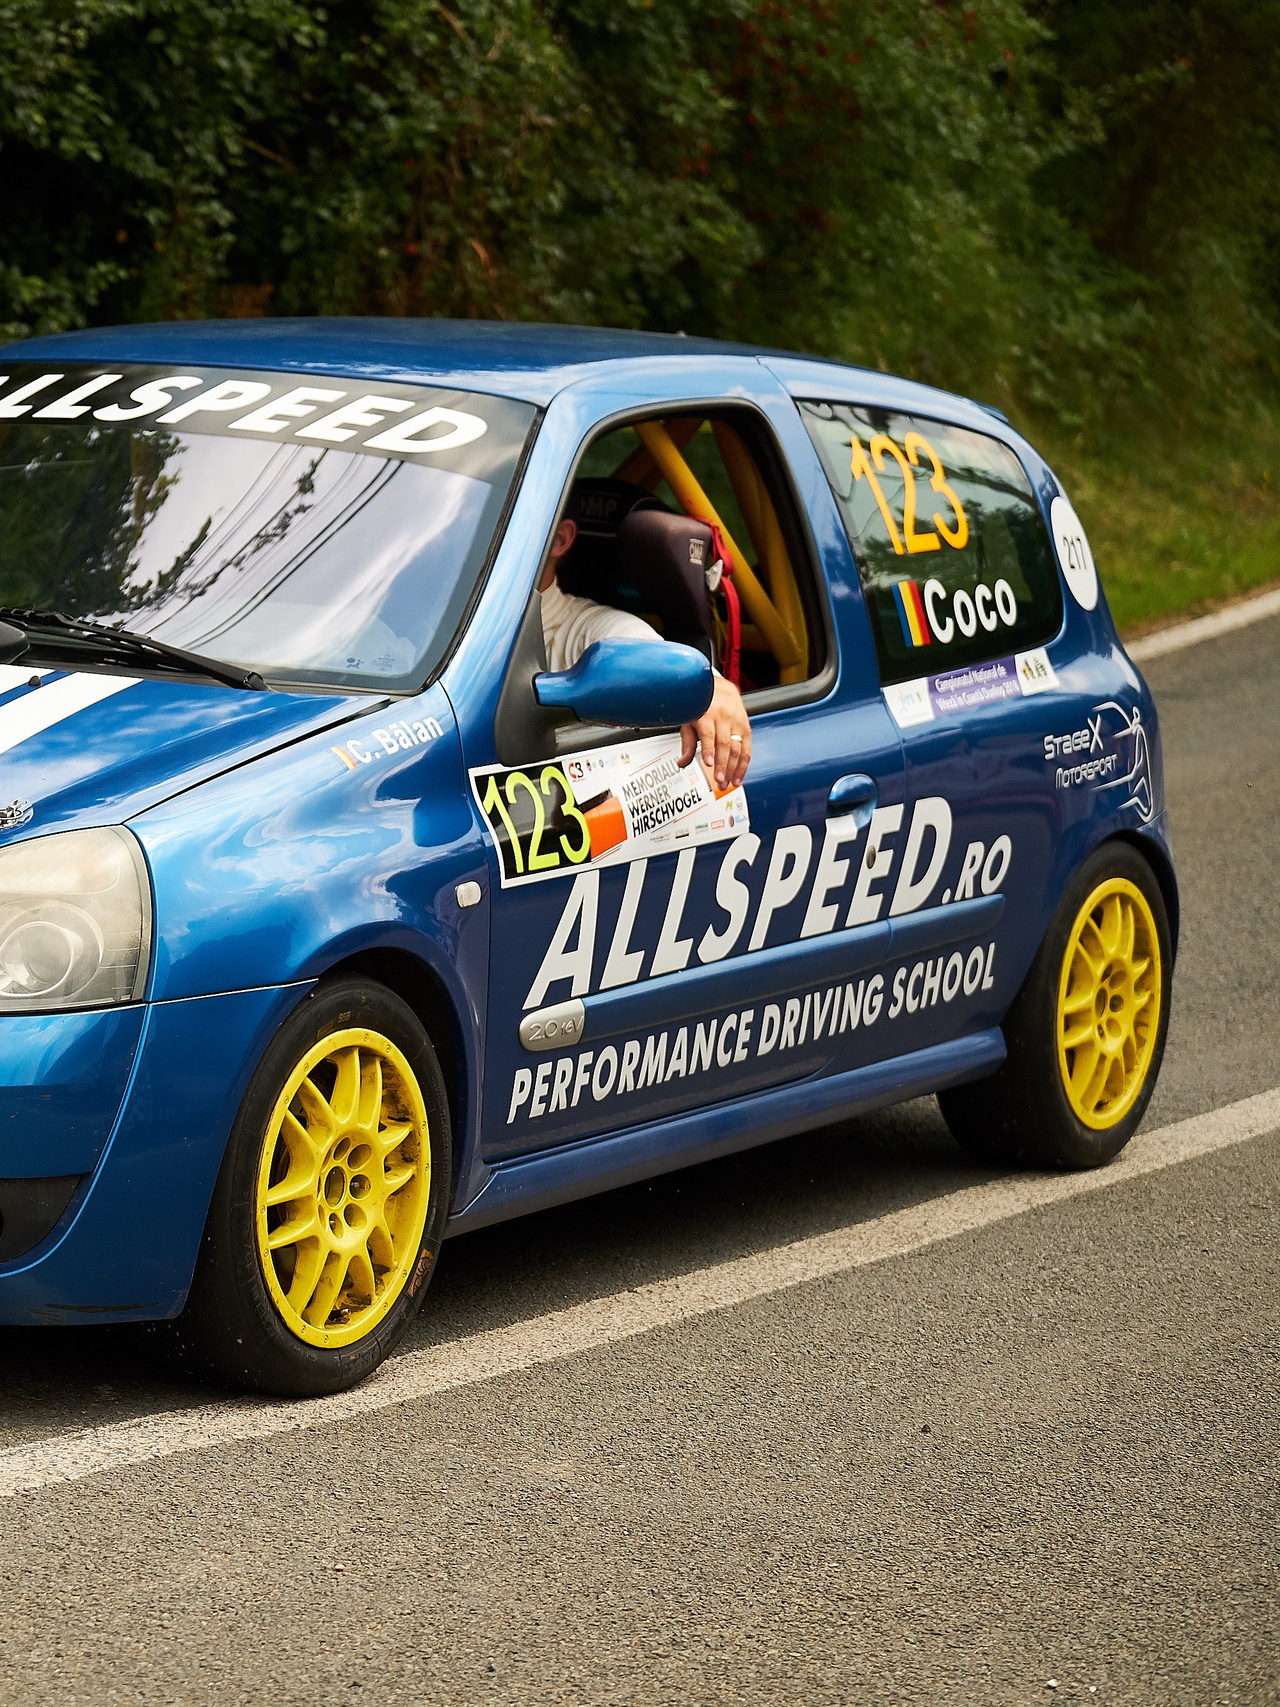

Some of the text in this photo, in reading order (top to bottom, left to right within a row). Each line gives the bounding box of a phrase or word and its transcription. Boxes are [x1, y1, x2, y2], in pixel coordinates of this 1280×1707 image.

[850, 431, 968, 555] 123
[1062, 535, 1088, 570] 217
[923, 578, 1017, 643] Coco
[346, 739, 381, 764] C.
[621, 755, 686, 802] MEMORIALU
[627, 785, 672, 819] WERNER
[483, 765, 591, 873] 123
[631, 786, 703, 838] HIRSCHVOGEL
[522, 796, 1012, 1010] ALLSPEED.RO
[507, 942, 997, 1124] PERFORMANCE DRIVING SCHOOL
[529, 1019, 558, 1041] 2.0
